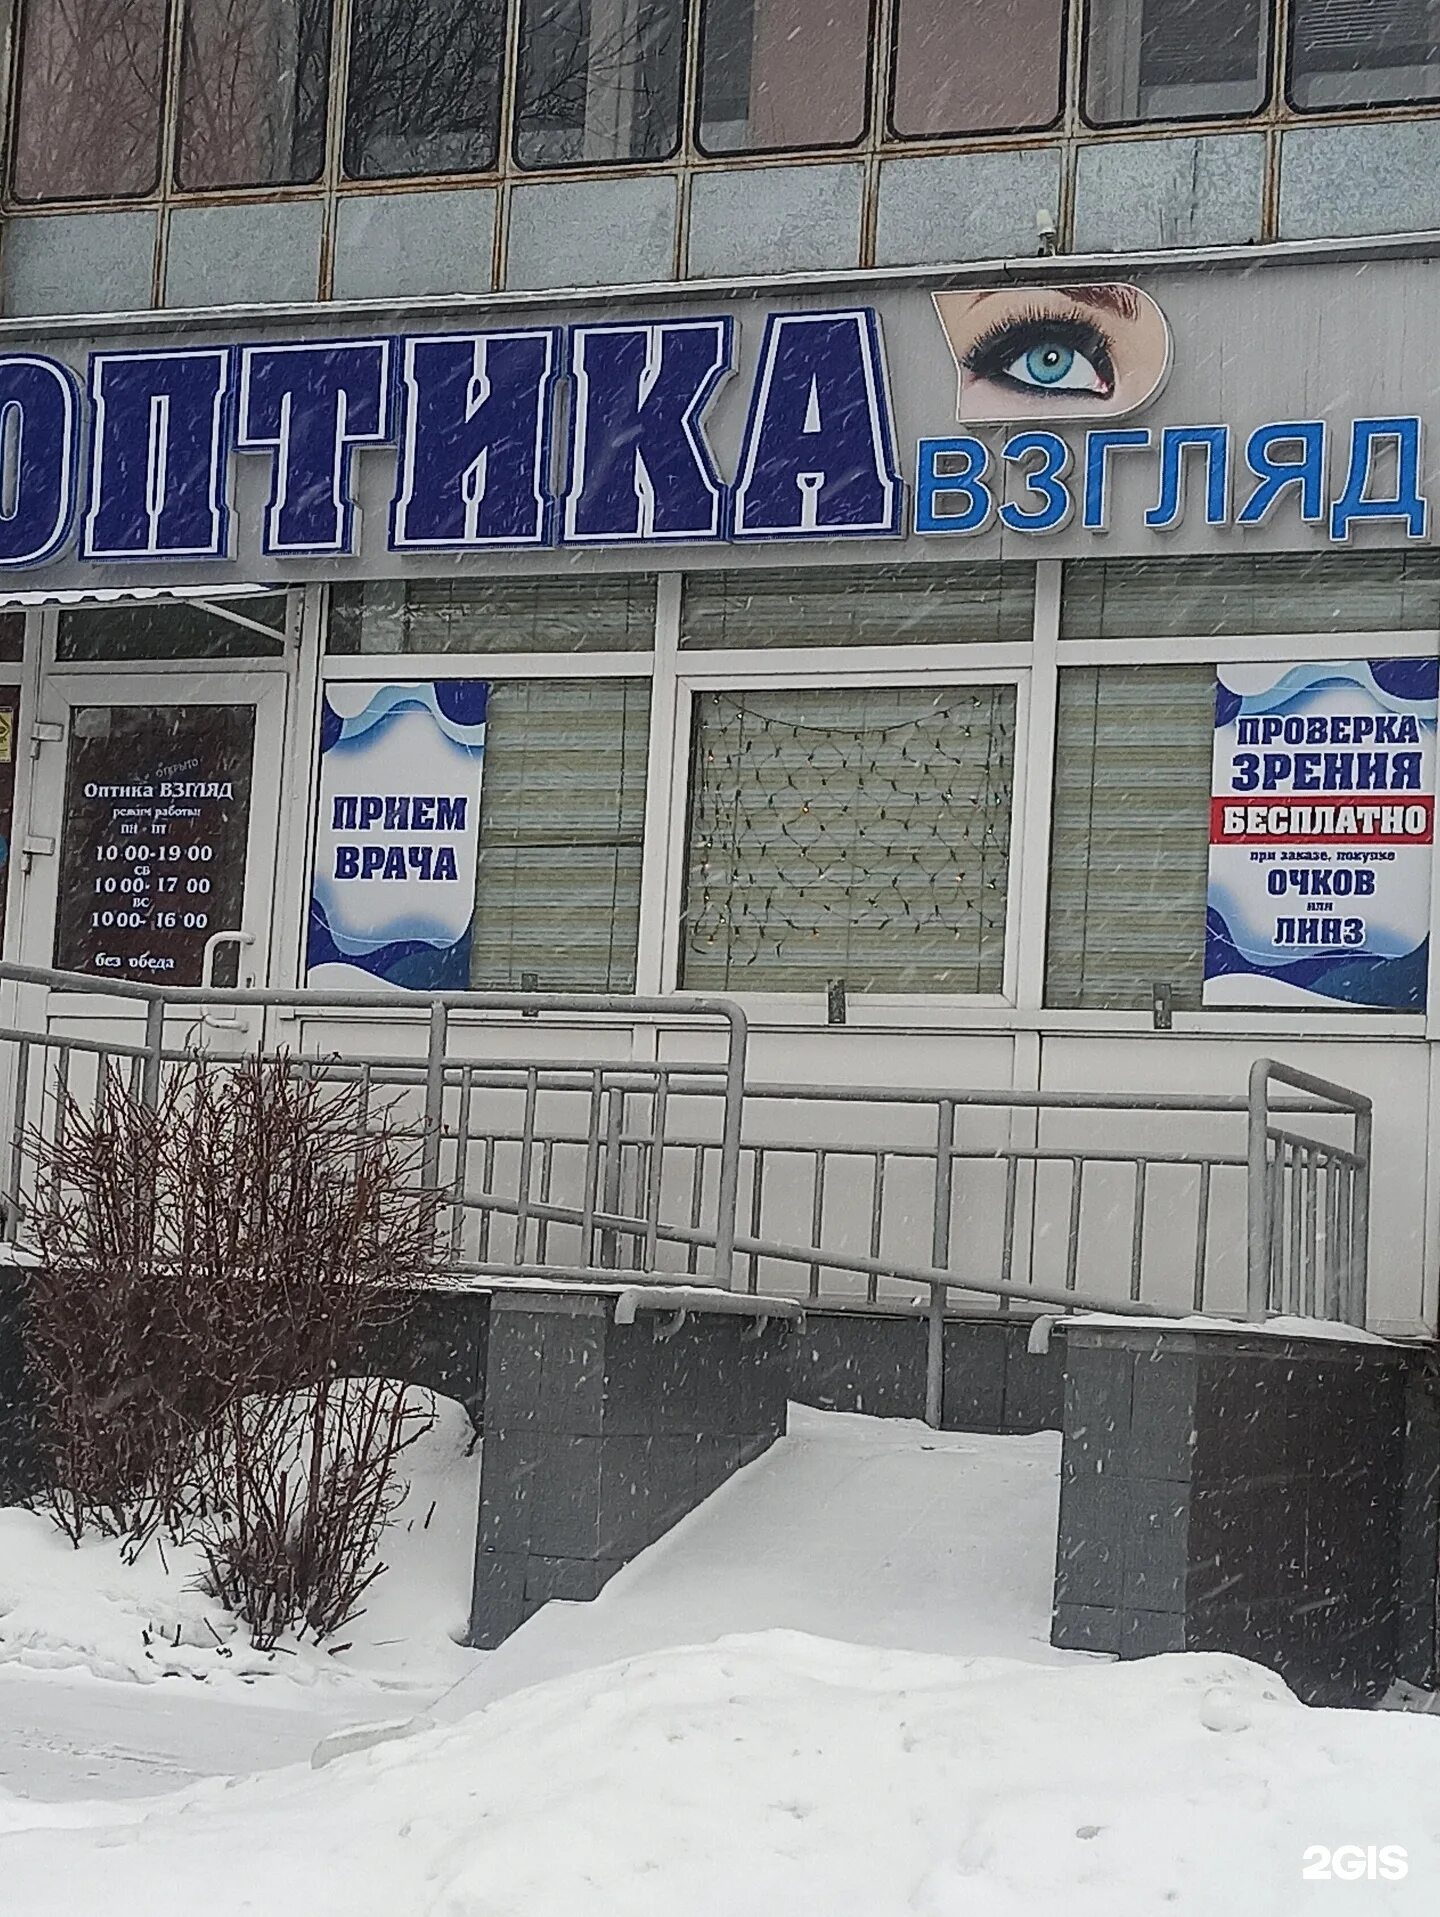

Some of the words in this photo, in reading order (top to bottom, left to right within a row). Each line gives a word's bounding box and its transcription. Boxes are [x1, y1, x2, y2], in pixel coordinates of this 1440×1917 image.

[0, 307, 902, 572] ОПТИКА
[914, 416, 1428, 541] ВЗГЛЯД
[1237, 715, 1420, 746] ПРОВЕРКА
[1231, 752, 1423, 791] ЗРЕНИЯ
[84, 783, 153, 798] Оптика
[160, 782, 233, 800] ВЗГЛЯД
[332, 796, 468, 830] ПРИЕМ
[1223, 806, 1427, 834] БЕСПЛАТНО
[334, 846, 458, 880] ВРАЧА
[1250, 852, 1276, 863] при
[1267, 869, 1375, 896] ОЧКОВ
[1306, 902, 1333, 911] или
[1274, 918, 1364, 944] ЛИНЗ
[95, 953, 121, 966] без
[128, 952, 175, 969] обеда
